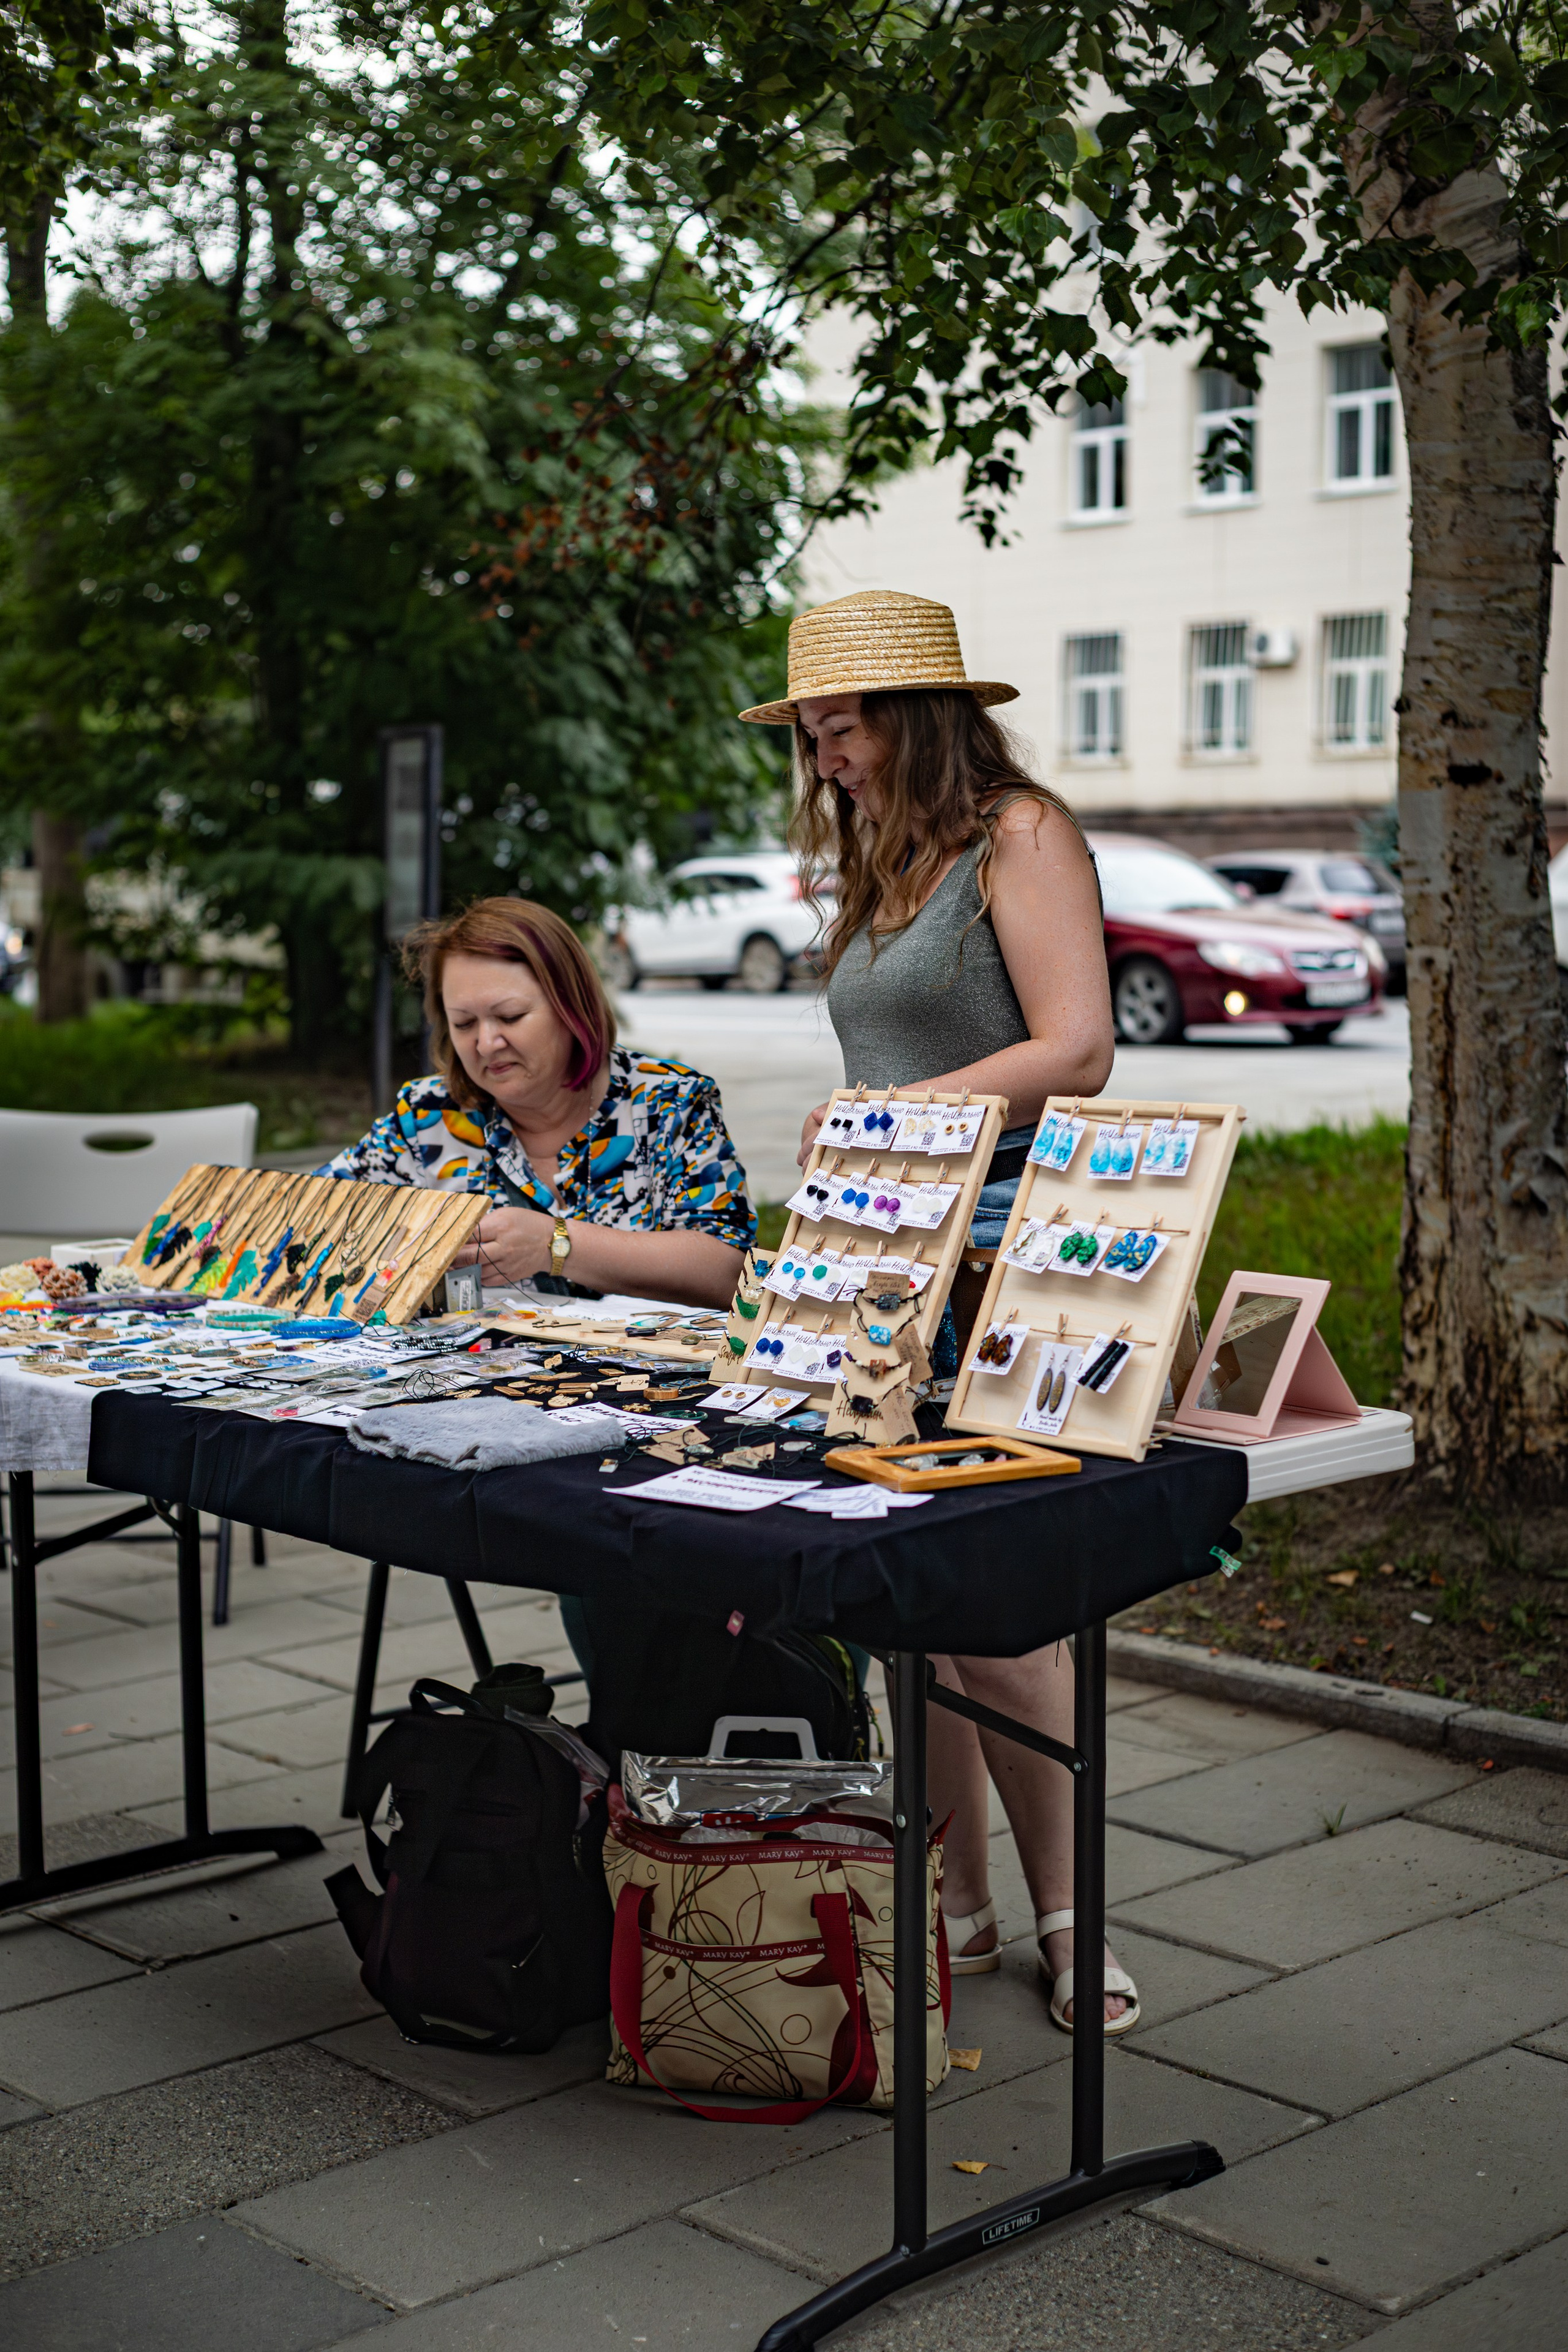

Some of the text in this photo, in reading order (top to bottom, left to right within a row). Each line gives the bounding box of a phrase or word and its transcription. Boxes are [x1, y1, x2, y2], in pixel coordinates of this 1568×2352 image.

[701, 1854, 728, 1863] MARY
[758, 1850, 783, 1859] MARY
[864, 1851, 884, 1860] MARY
[654, 1942, 674, 1953] MARY
[760, 1947, 785, 1957] MARY
[989, 2213, 1033, 2239] LIFETIME
